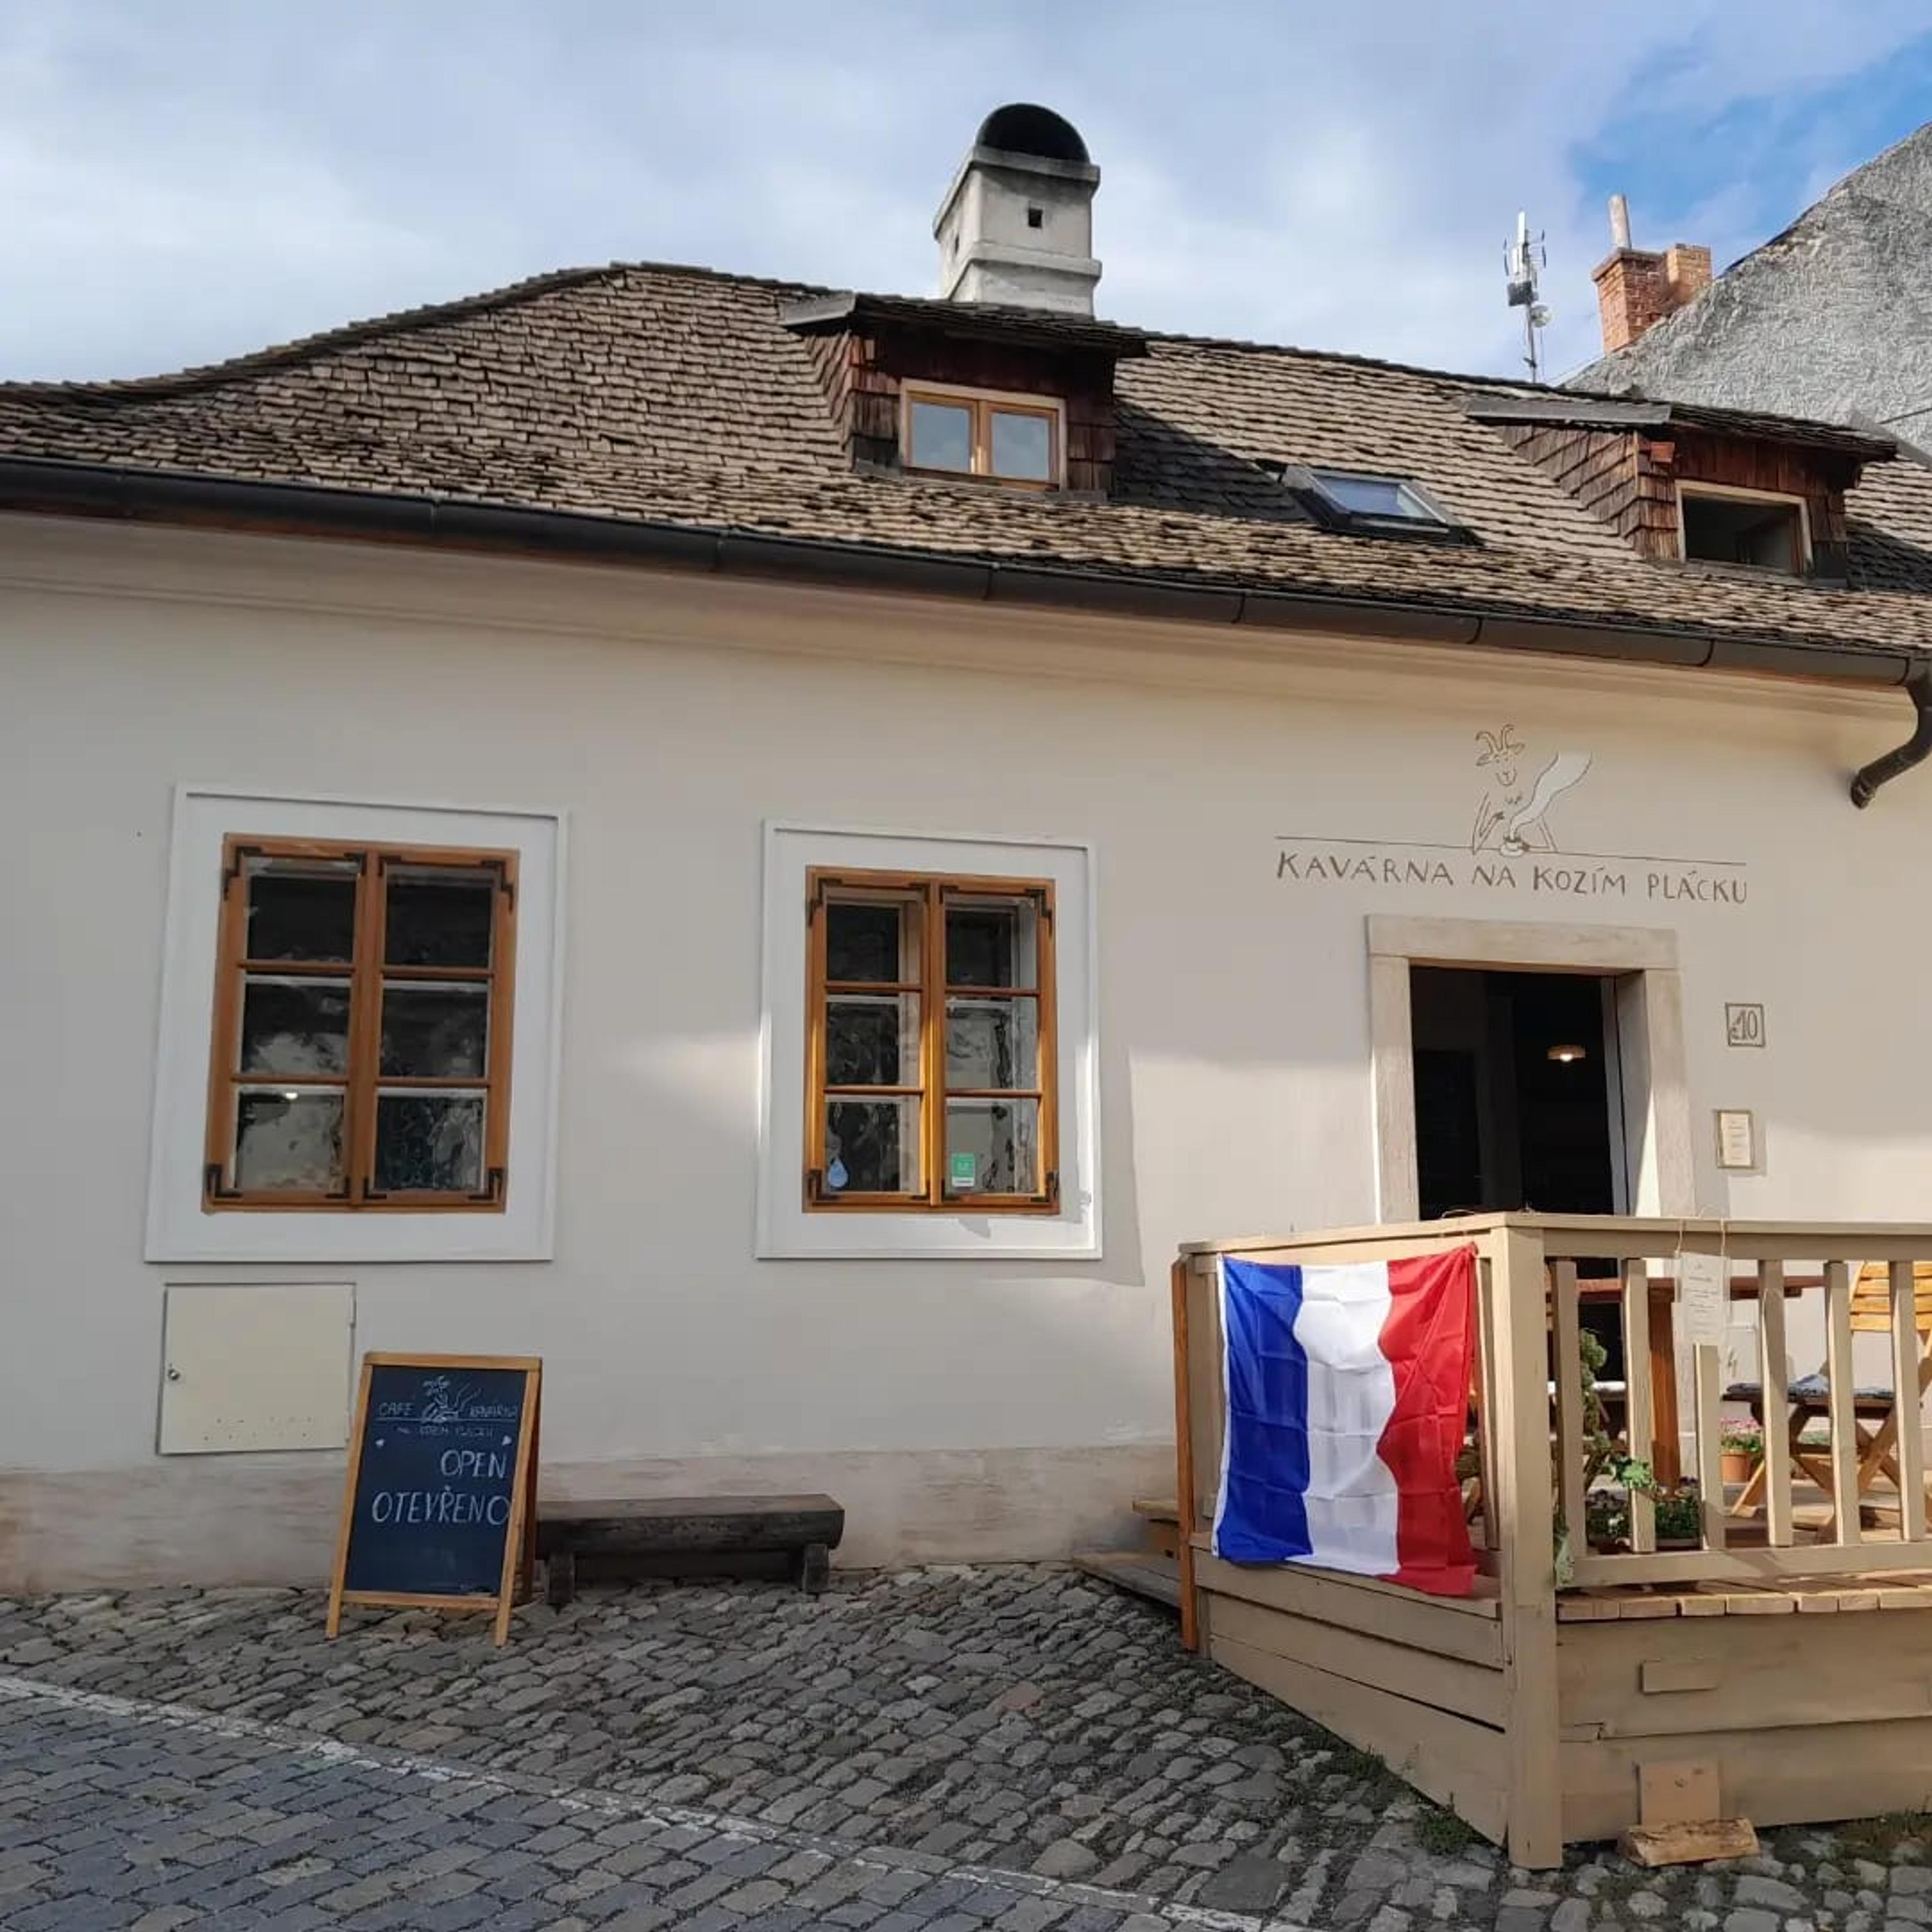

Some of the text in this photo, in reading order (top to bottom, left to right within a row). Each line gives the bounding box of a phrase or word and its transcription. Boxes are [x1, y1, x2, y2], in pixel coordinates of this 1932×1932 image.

[1277, 851, 1747, 904] KAVÁRNA NA KOZÍM PLÁCKU
[440, 1449, 506, 1478] OPEN
[372, 1485, 511, 1525] OTEVŘENO
